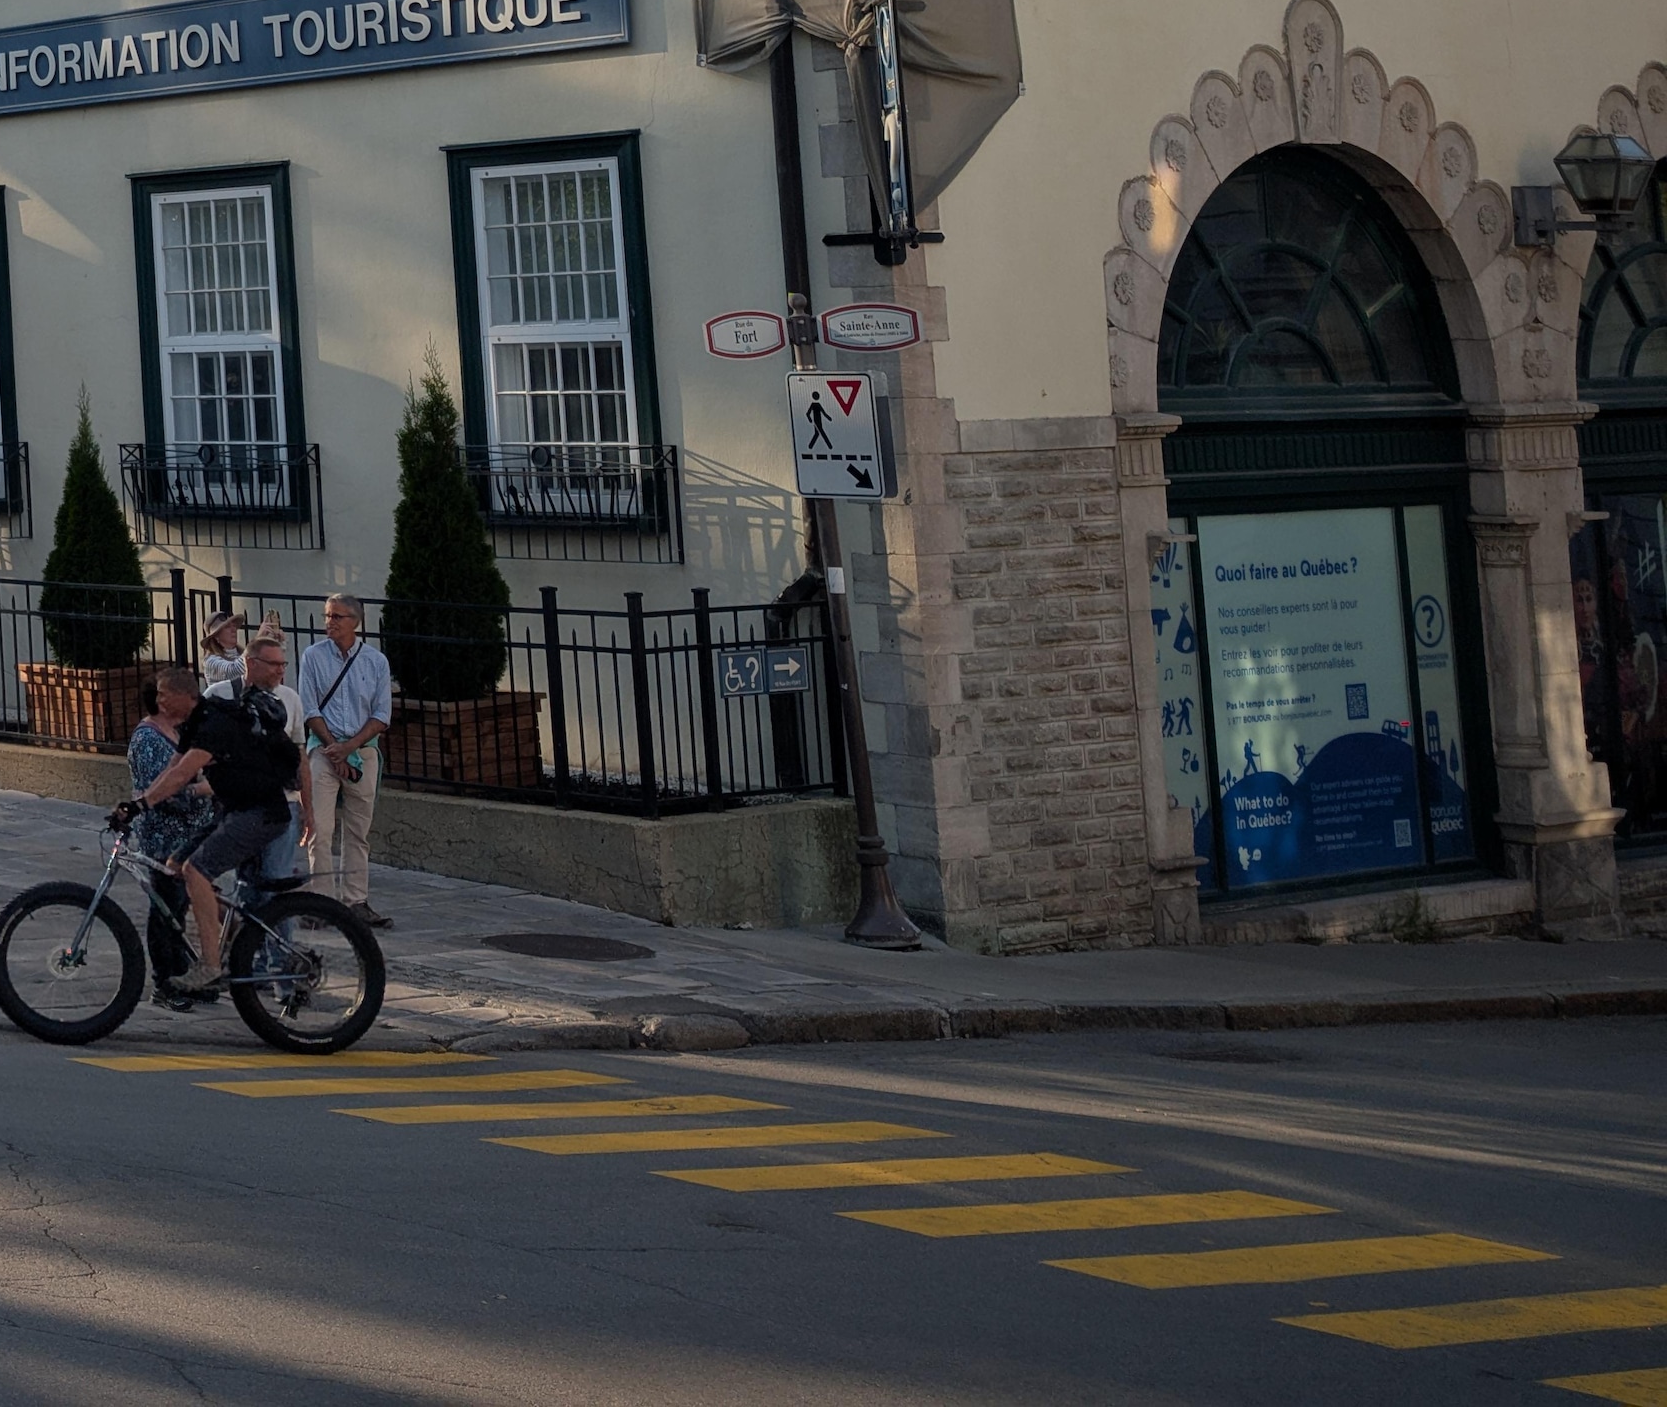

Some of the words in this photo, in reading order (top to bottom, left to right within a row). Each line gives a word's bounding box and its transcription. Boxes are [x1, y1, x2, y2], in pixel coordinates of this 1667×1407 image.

[839, 320, 900, 332] Sainte-Anne
[734, 330, 758, 344] Fort
[1215, 563, 1246, 582] Quoi
[1249, 562, 1278, 580] faire
[1282, 565, 1297, 578] au
[1300, 557, 1348, 577] Québec
[1218, 606, 1235, 619] Nos
[1237, 603, 1279, 618] conseillers
[1281, 602, 1310, 615] experts
[1312, 600, 1330, 613] sont
[1330, 599, 1338, 611] là
[1340, 599, 1358, 612] pour
[1219, 623, 1239, 635] vous
[1241, 620, 1266, 637] guider
[1221, 649, 1247, 661] Entrez
[1249, 648, 1262, 659] les
[1263, 646, 1279, 658] voir
[1281, 647, 1299, 659] pour
[1301, 642, 1330, 657] profiter
[1332, 641, 1342, 653] de
[1344, 639, 1364, 651] leurs
[1223, 662, 1295, 678] recommandations
[1226, 701, 1238, 711] Pas
[1239, 700, 1245, 709] le
[1245, 698, 1265, 710] temps
[1266, 697, 1275, 707] de
[1276, 697, 1290, 707] vous
[1243, 714, 1272, 724] BONJOUR
[1234, 795, 1261, 812] What
[1262, 795, 1274, 809] to
[1275, 792, 1290, 808] do
[1236, 815, 1247, 830] in
[1248, 810, 1293, 829] Québec?
[1430, 817, 1465, 835] québec
